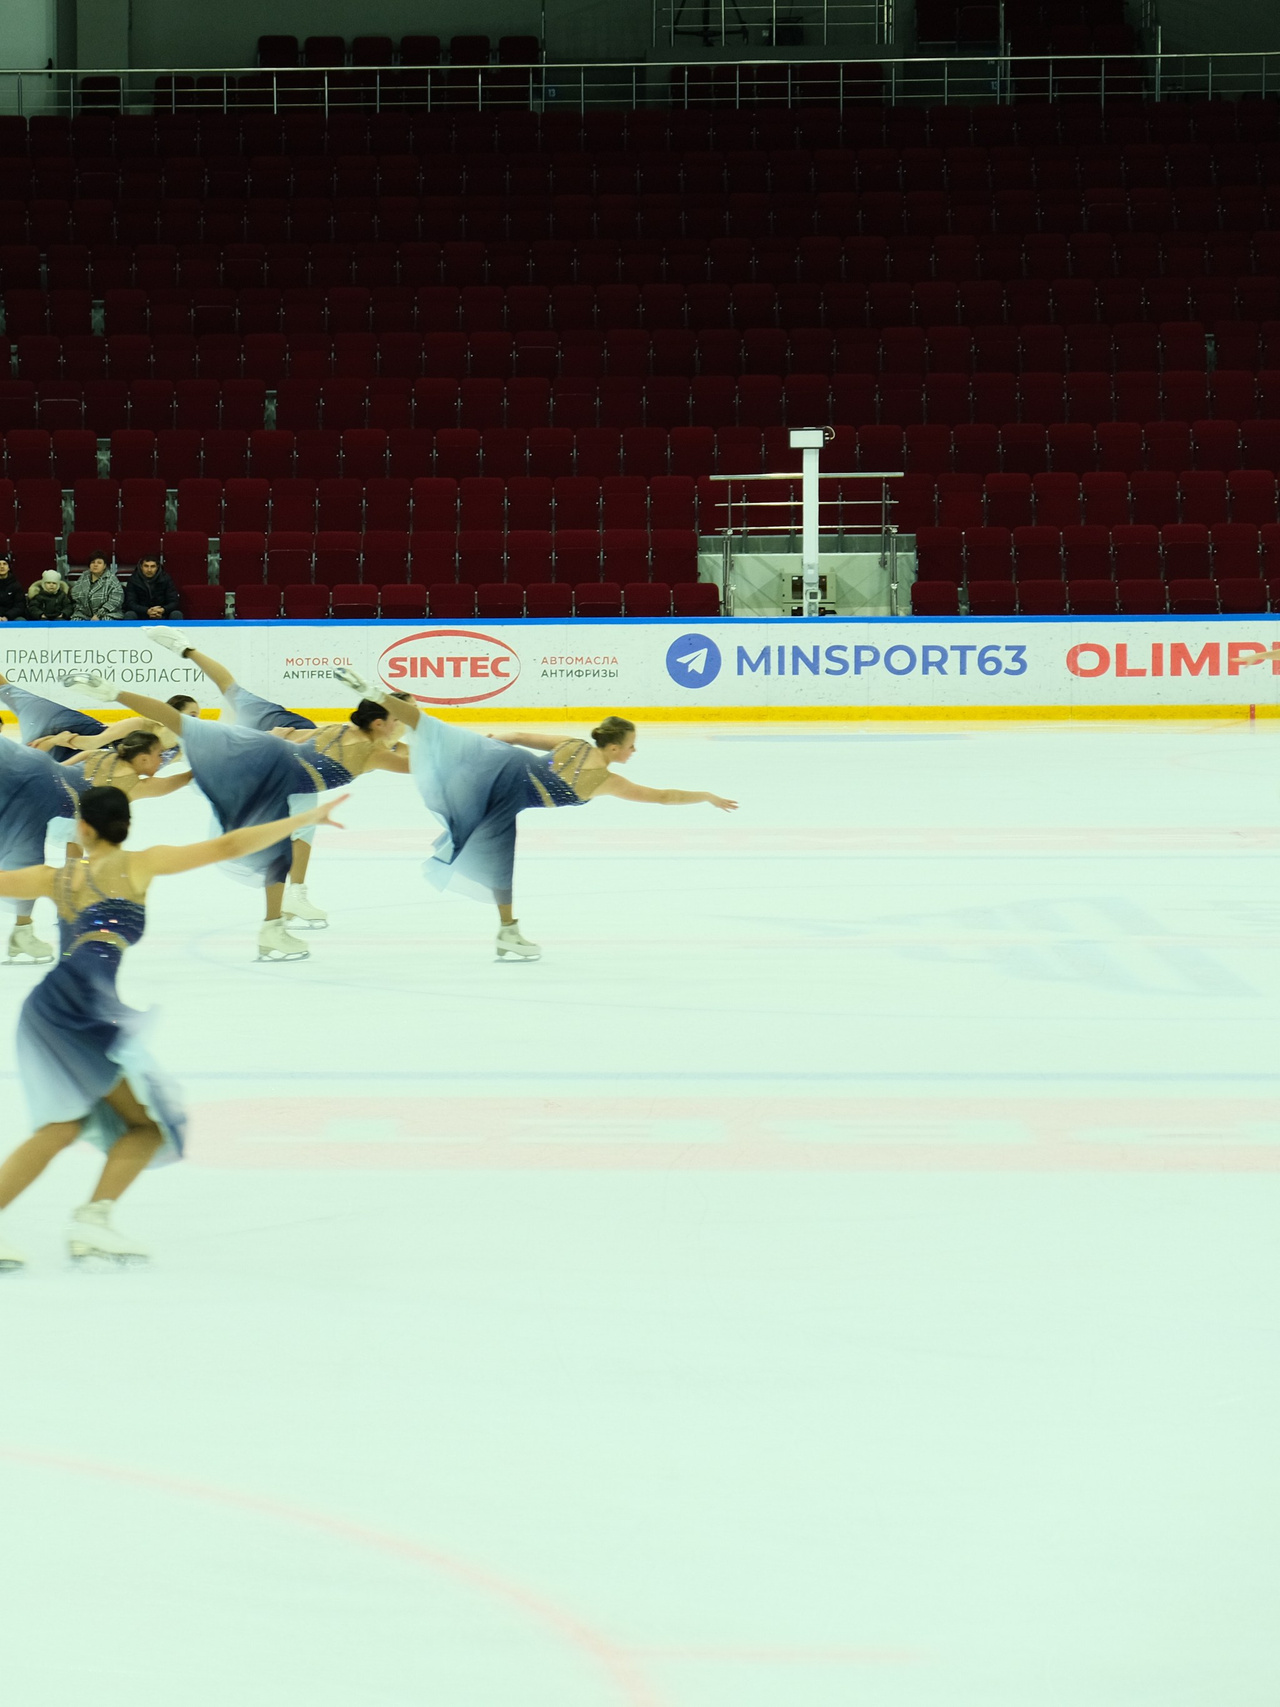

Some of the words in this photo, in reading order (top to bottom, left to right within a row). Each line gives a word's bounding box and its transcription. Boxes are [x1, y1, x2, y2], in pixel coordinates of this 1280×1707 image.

[5, 649, 153, 665] ПРАВИТЕЛЬСТВО
[285, 657, 329, 667] MOTOR
[333, 657, 353, 666] OIL
[541, 655, 619, 665] АВТОМАСЛА
[736, 644, 1028, 677] MINSPORT63
[121, 667, 206, 683] ОБЛАСТИ
[388, 656, 511, 678] SINTEC
[541, 667, 619, 678] АНТИФРИЗЫ
